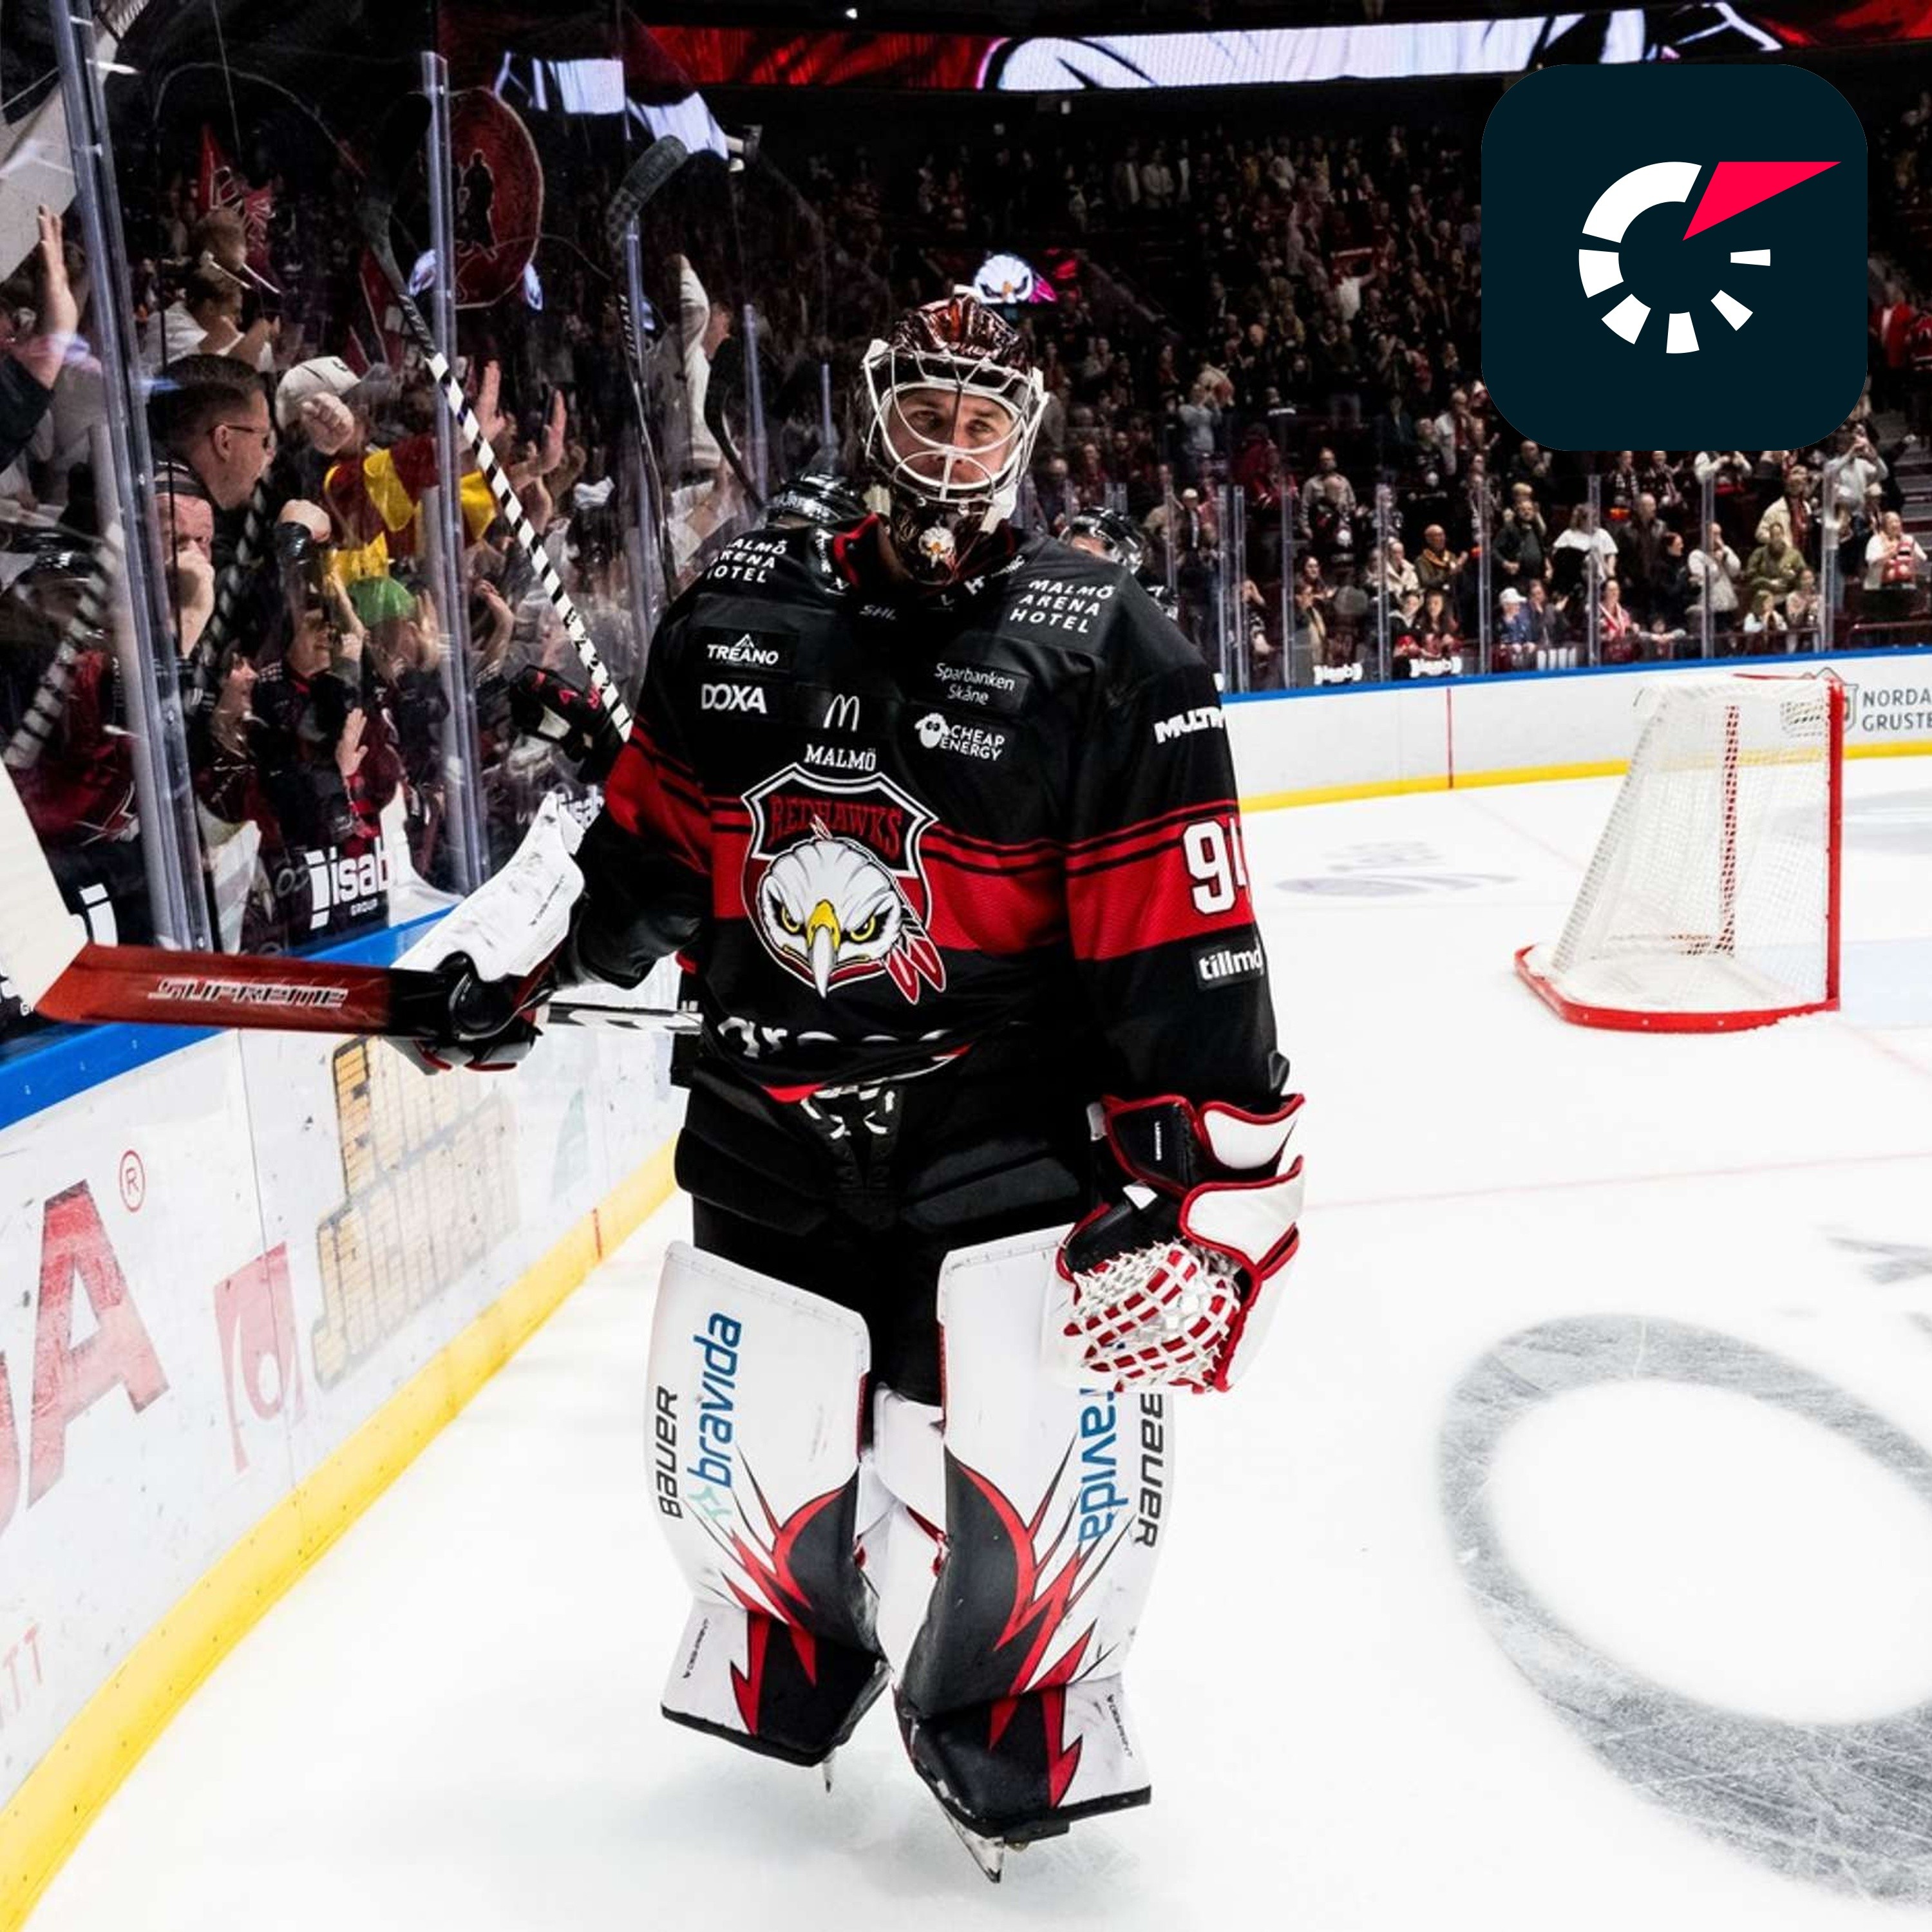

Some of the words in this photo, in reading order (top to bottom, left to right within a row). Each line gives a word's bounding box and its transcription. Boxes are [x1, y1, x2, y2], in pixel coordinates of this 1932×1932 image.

[726, 538, 787, 554] ALMÖ
[1028, 580, 1115, 600] MALMÖ
[1018, 594, 1100, 616] ARENA
[1009, 608, 1088, 634] HOTEL
[934, 663, 1016, 691] Sparbanken
[701, 683, 767, 714] DOXA
[947, 683, 989, 706] Skåne
[1863, 688, 1931, 706] NORDA
[951, 724, 1005, 747] CHEAP
[804, 743, 876, 772] MALMÖ
[939, 737, 1002, 761] ENERGY
[766, 795, 903, 860] REDHAWKS
[148, 977, 348, 1008] SUPREME
[687, 1311, 743, 1488] bravida
[655, 1385, 684, 1520] BAUER
